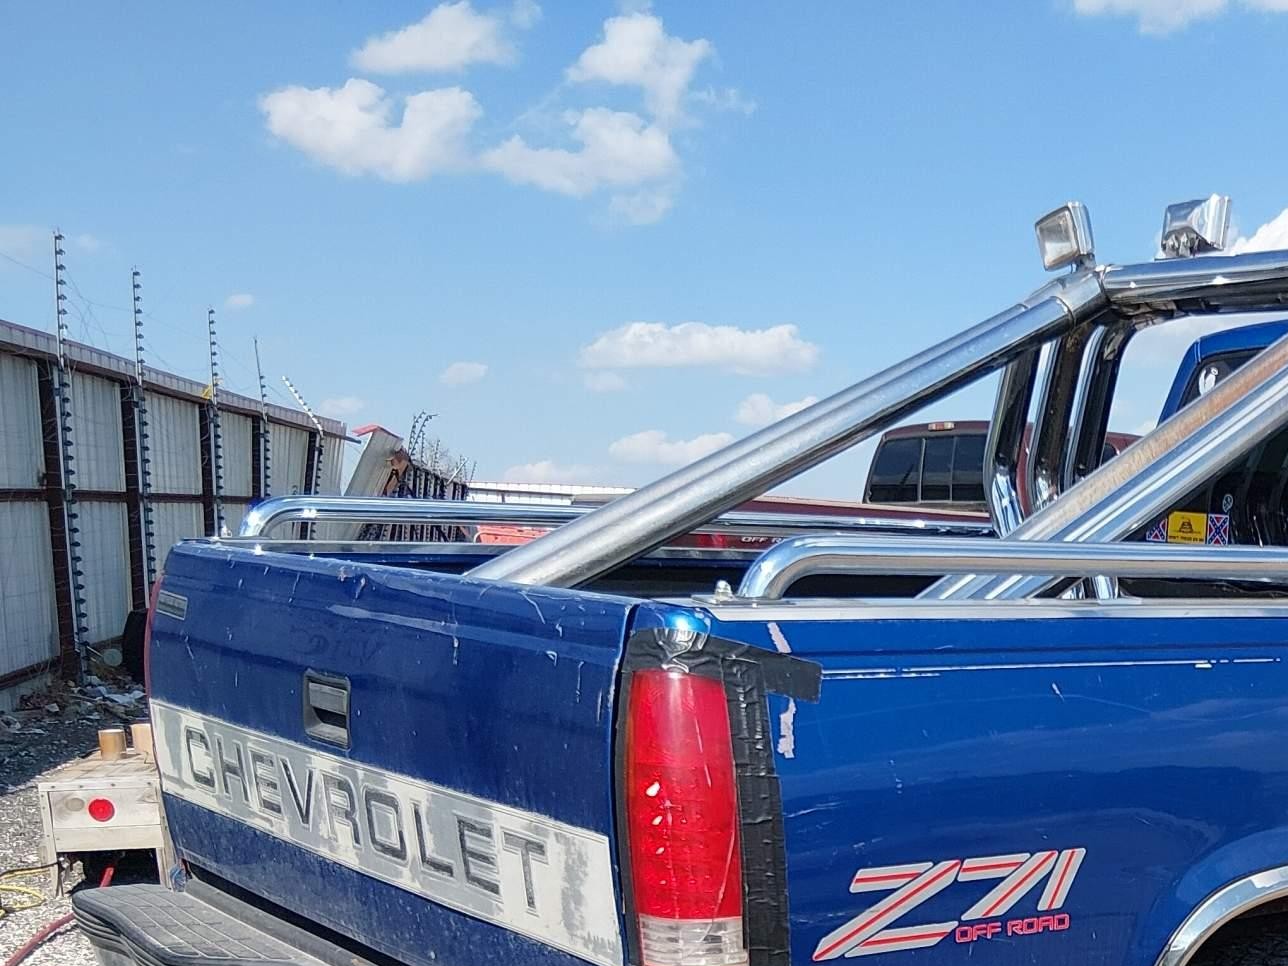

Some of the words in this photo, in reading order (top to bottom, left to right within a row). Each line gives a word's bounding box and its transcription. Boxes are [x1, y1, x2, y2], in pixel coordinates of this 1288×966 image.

[184, 725, 549, 918] CHEVROLET
[812, 847, 1087, 962] Z71
[955, 920, 1002, 944] OFF
[1007, 913, 1071, 937] ROAD
